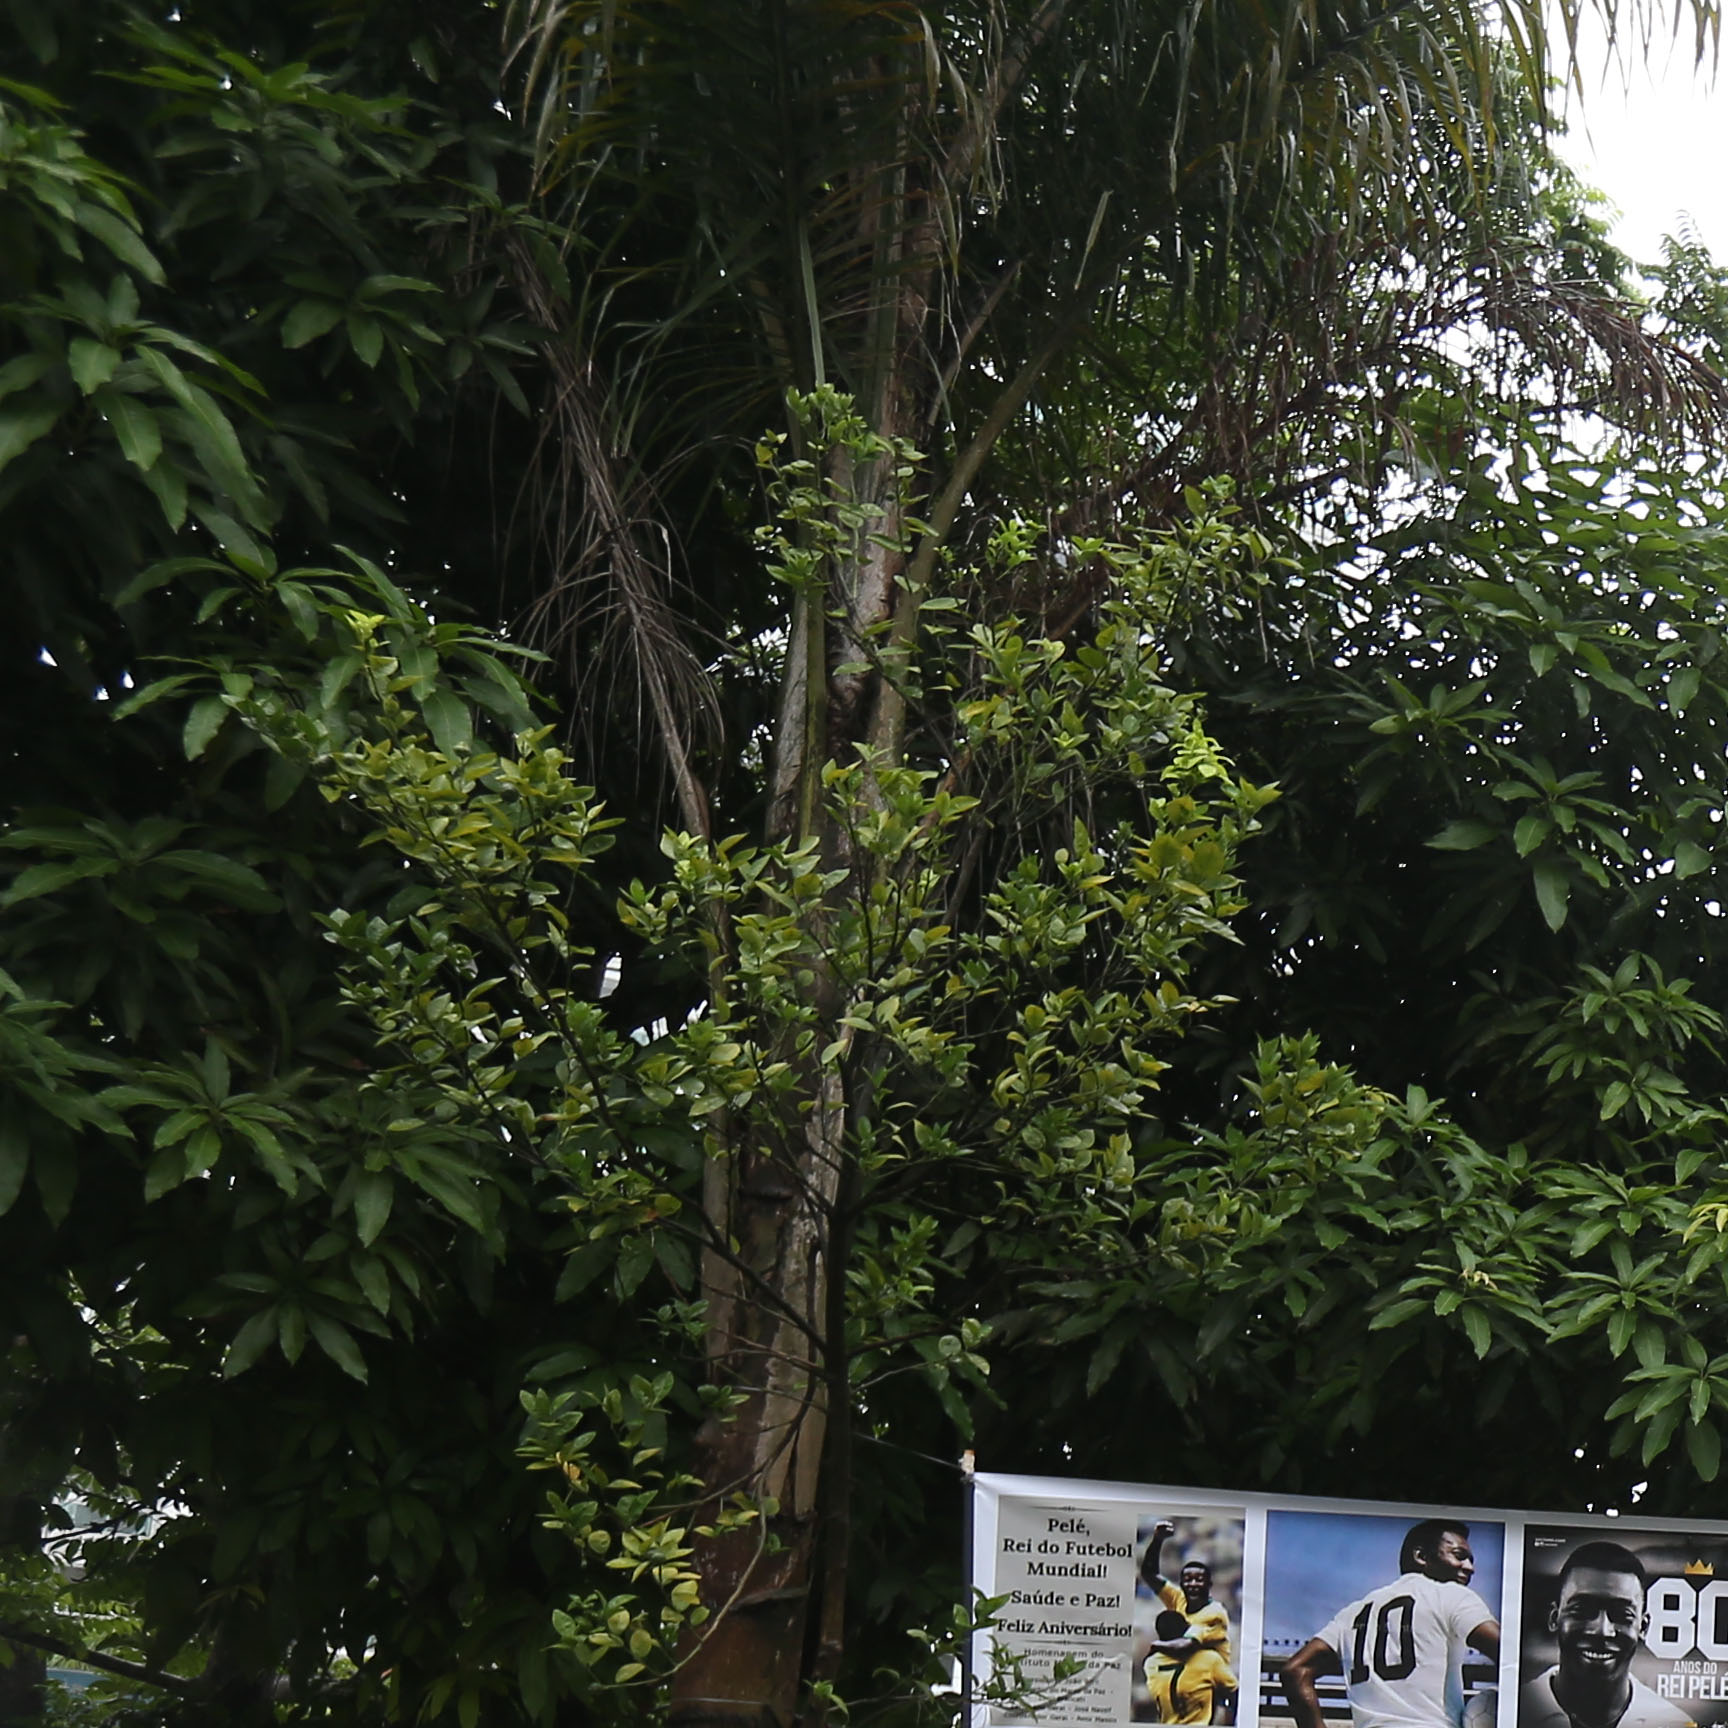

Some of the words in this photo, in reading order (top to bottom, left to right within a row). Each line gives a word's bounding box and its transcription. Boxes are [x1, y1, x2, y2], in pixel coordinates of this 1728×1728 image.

[1048, 1518, 1090, 1537] Pelé,
[1003, 1538, 1031, 1553] Rei
[1038, 1540, 1060, 1555] do
[1065, 1541, 1133, 1559] Futebol
[1027, 1561, 1108, 1579] Mundial!
[1011, 1589, 1065, 1606] Saúde
[1070, 1596, 1080, 1607] e
[1085, 1592, 1120, 1609] Paz!
[997, 1618, 1035, 1634] Feliz
[1038, 1621, 1133, 1638] Aniversário!
[1351, 1595, 1416, 1684] 10
[1024, 1648, 1088, 1659] Homenaem
[1091, 1650, 1104, 1658] do
[1673, 1660, 1702, 1675] ANOS
[1703, 1661, 1718, 1676] DO
[1657, 1674, 1686, 1700] REI
